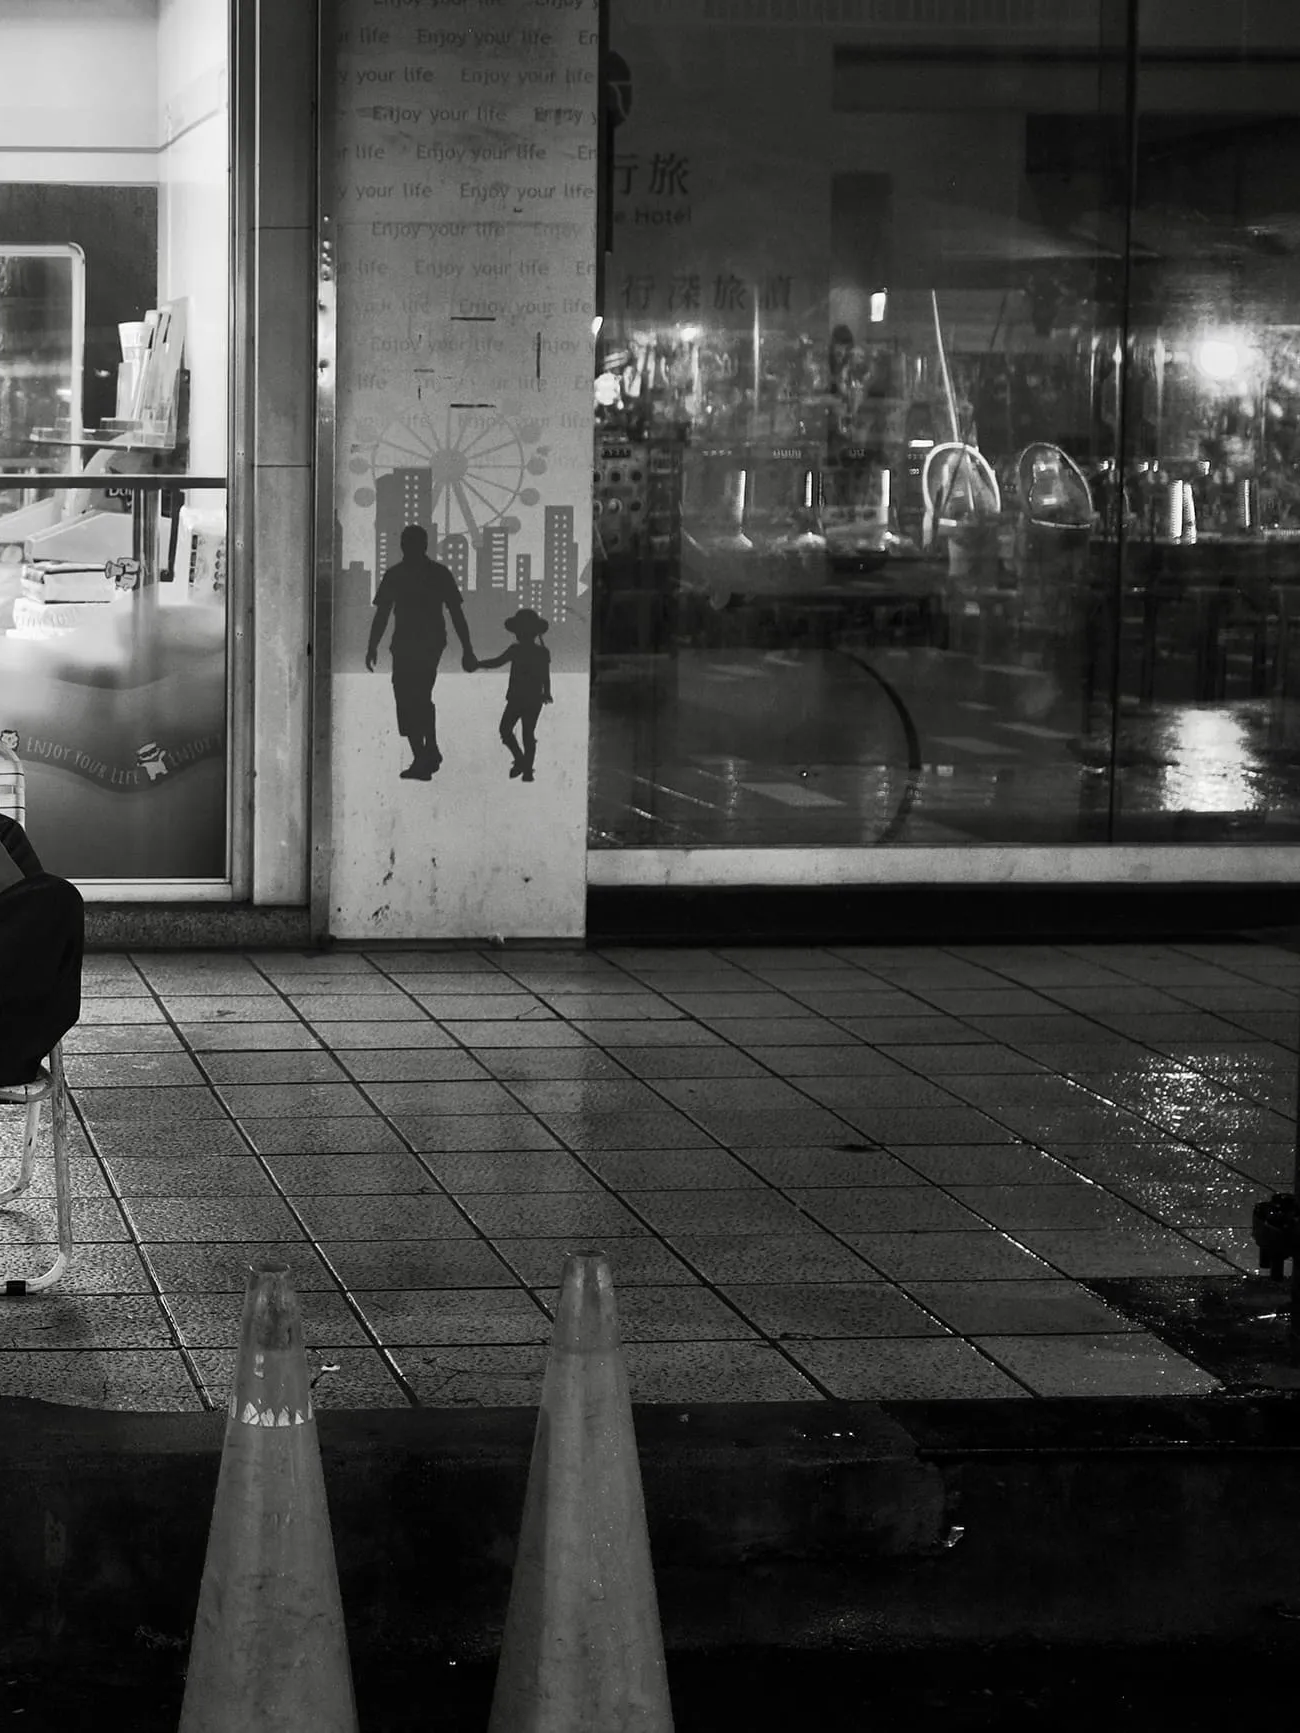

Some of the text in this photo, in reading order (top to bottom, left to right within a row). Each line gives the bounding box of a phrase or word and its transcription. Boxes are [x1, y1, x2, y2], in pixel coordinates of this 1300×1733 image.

[416, 29, 466, 48] Enjoy
[356, 69, 395, 85] your
[403, 66, 435, 84] life
[460, 67, 510, 87] Enjoy
[429, 108, 469, 125] your
[416, 144, 466, 164] Enjoy
[356, 184, 395, 200] your
[403, 182, 433, 199] life
[460, 183, 510, 203] Enjoy
[517, 186, 557, 202] your
[635, 205, 692, 225] Hotel
[371, 221, 421, 240] Enjoy
[27, 736, 71, 761] ENJOY
[75, 750, 108, 778] YOUR
